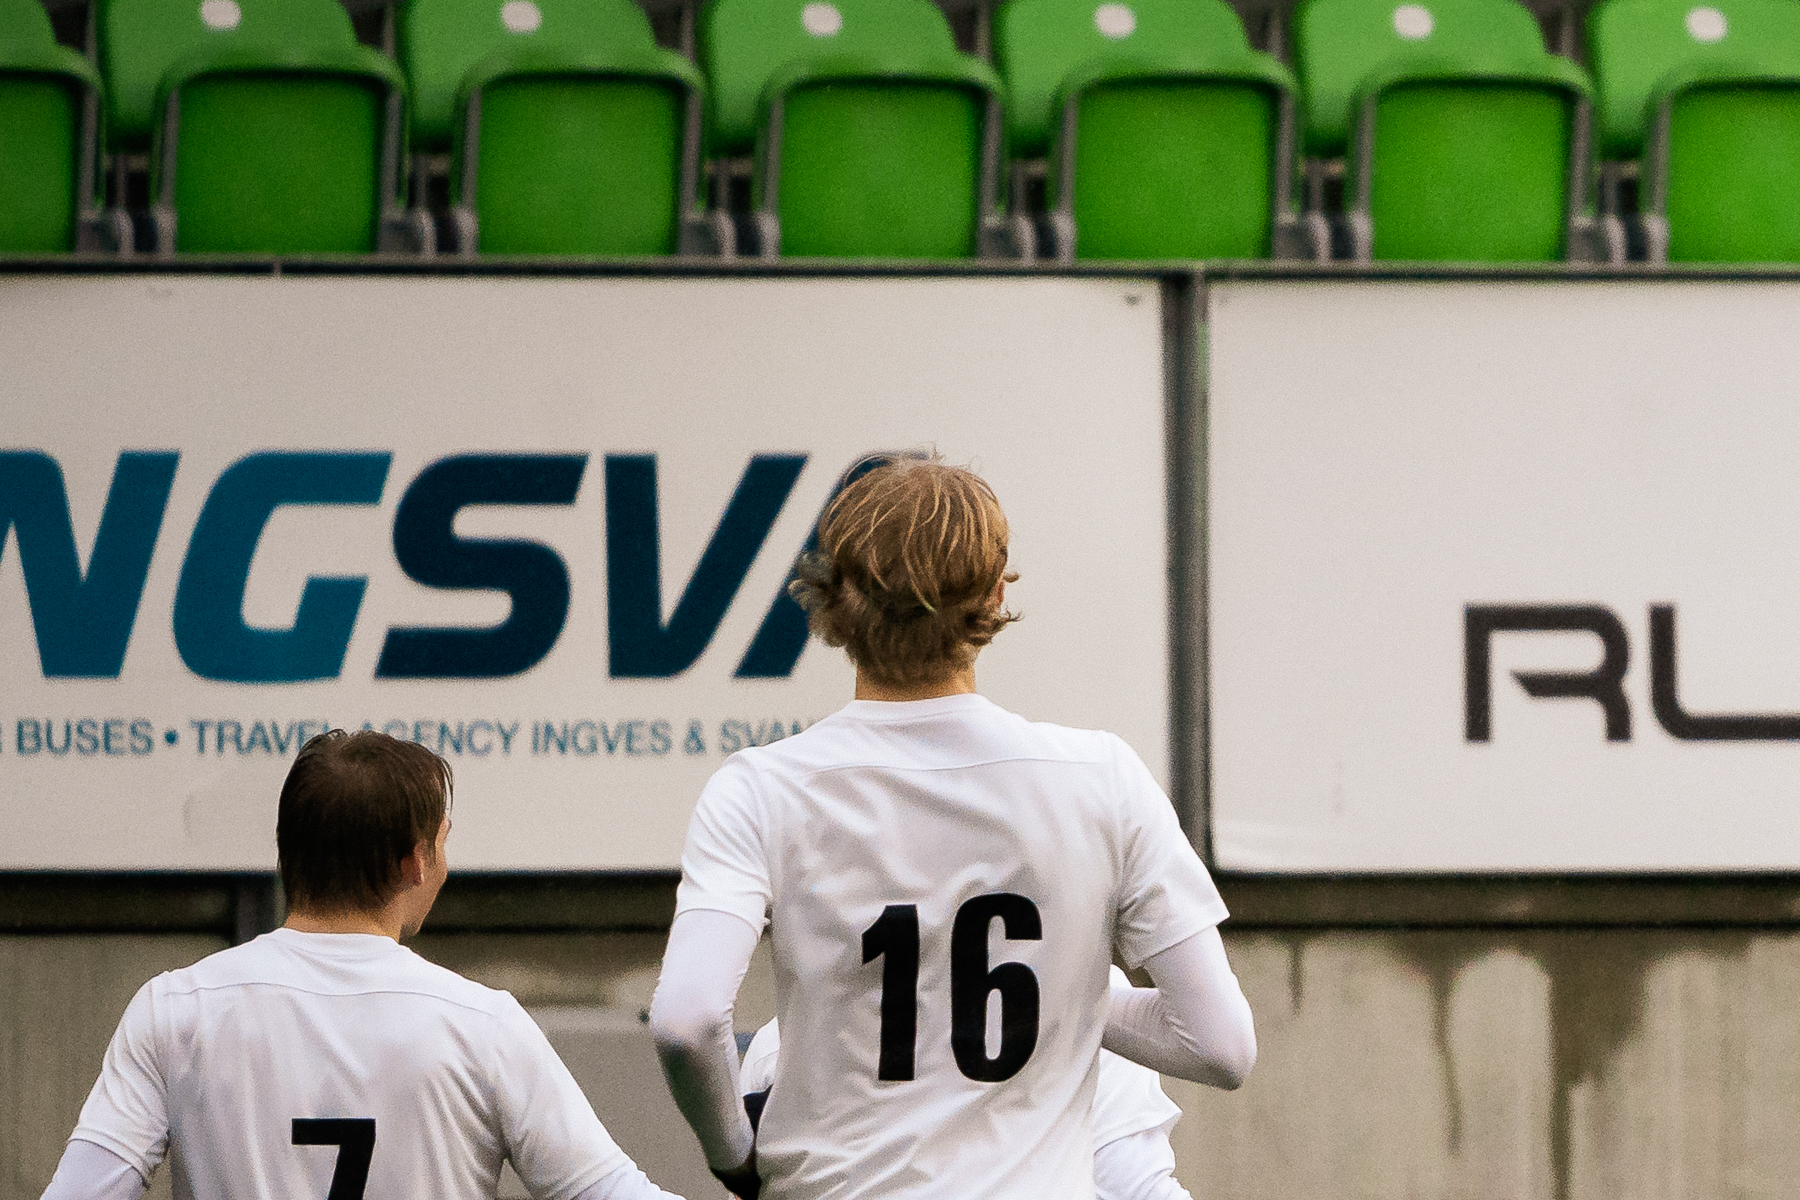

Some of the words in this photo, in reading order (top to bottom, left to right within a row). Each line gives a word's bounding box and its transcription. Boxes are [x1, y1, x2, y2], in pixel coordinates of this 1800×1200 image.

[16, 718, 154, 757] BUSES
[531, 720, 672, 756] INGVES
[685, 721, 706, 755] &
[861, 892, 1042, 1083] 16
